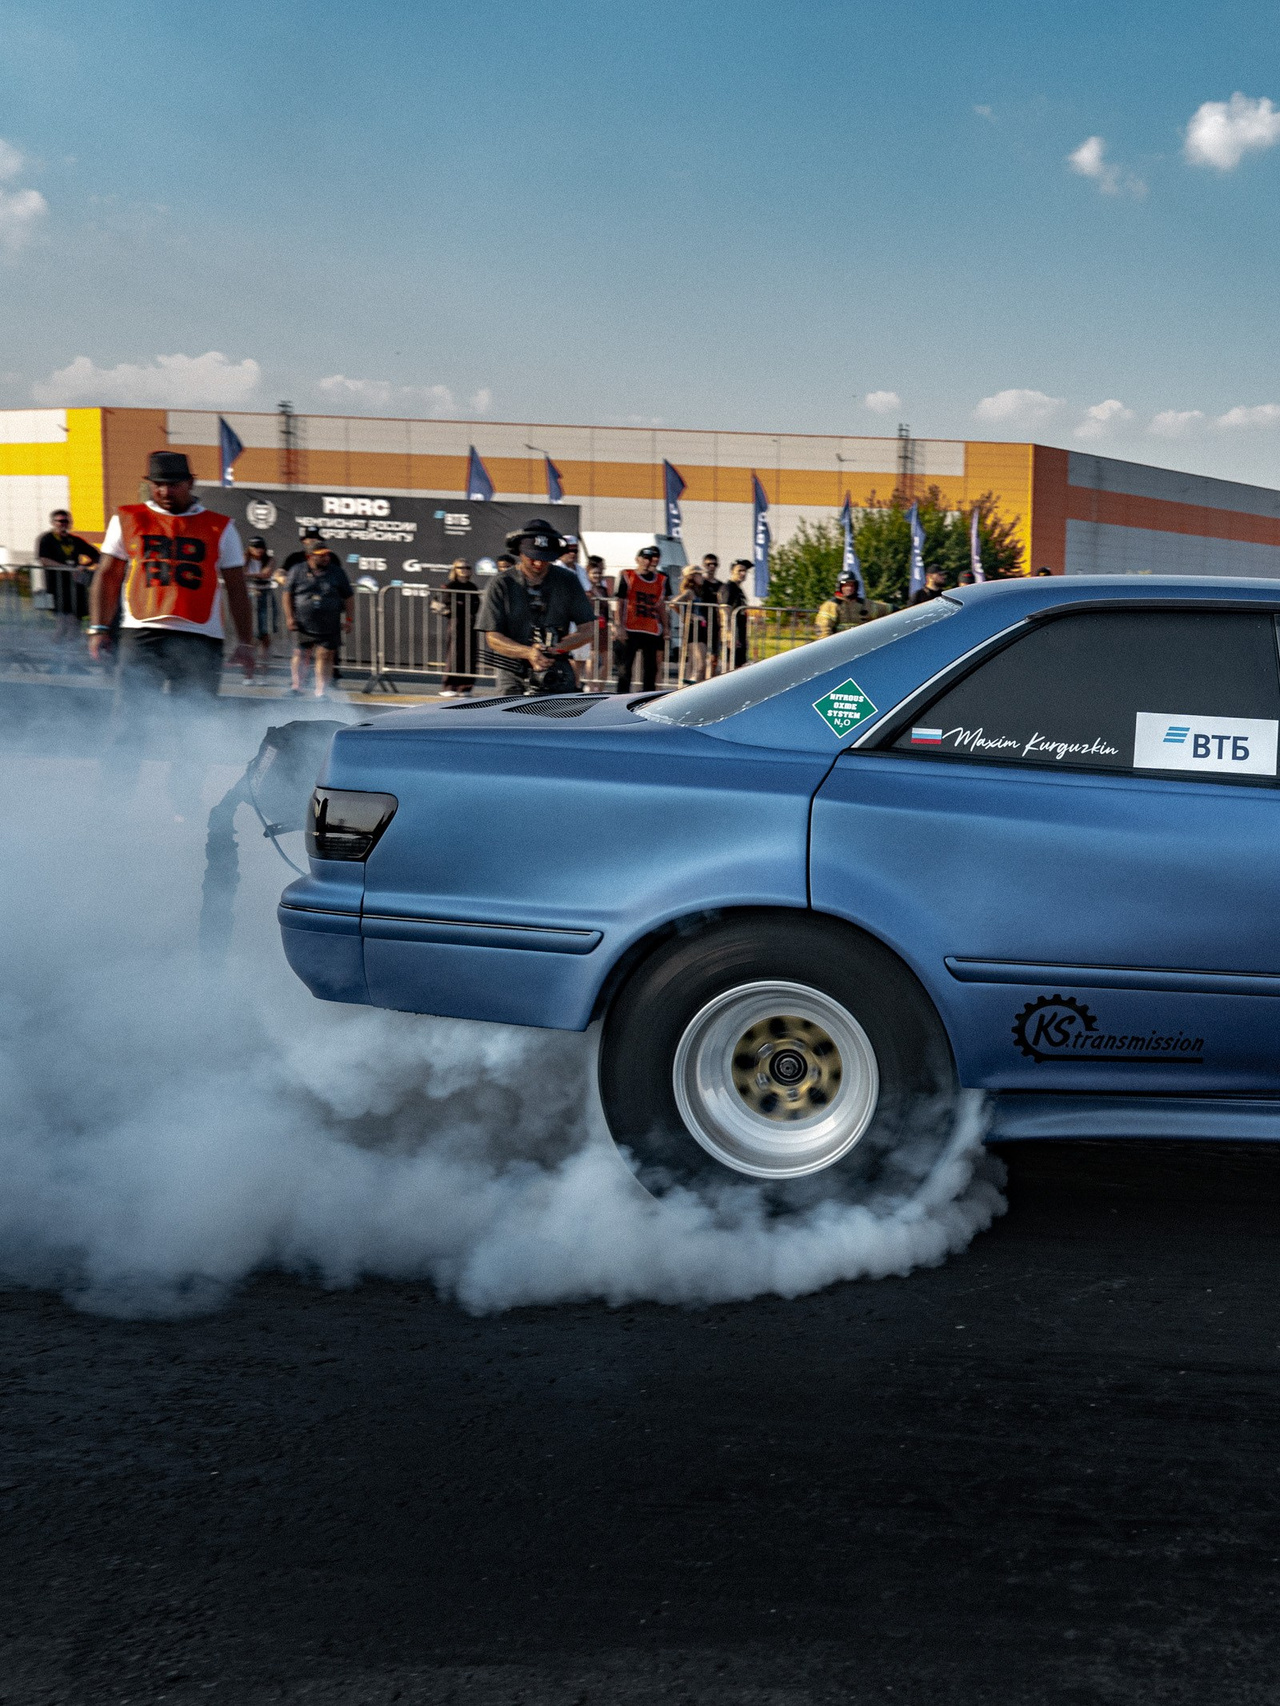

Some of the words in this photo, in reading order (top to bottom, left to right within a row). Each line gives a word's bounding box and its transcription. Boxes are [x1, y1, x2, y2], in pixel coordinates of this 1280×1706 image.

[321, 496, 391, 517] RDRC
[829, 693, 864, 702] NITROUS
[833, 702, 858, 710] OXIDE
[826, 709, 861, 719] SYSTEM
[942, 727, 1021, 752] Maxim
[1020, 732, 1119, 760] Kurguzkin
[1192, 733, 1250, 761] ВТБ
